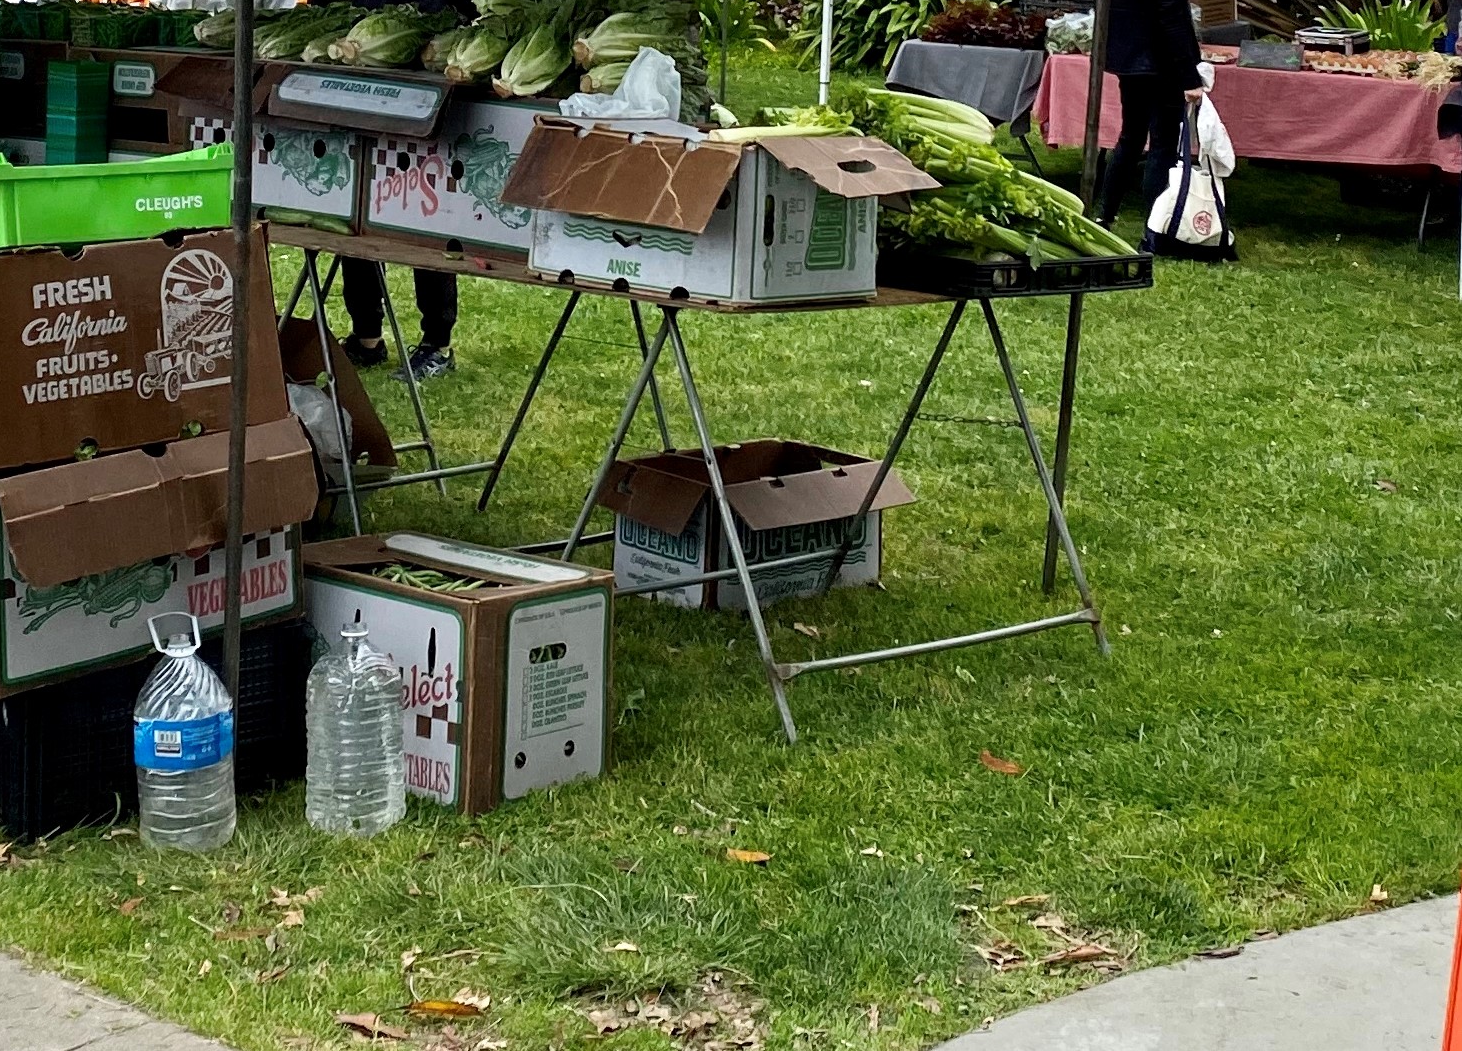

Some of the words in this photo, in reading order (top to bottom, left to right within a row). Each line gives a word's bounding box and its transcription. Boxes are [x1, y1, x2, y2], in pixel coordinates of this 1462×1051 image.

[320, 79, 371, 95] VEGETABLES
[372, 86, 401, 98] FRESH
[375, 154, 444, 217] Select
[135, 195, 203, 212] CLEUGH'S
[606, 258, 642, 277] ANISE
[32, 275, 112, 309] FRESH
[21, 309, 128, 355] California
[22, 369, 134, 404] VEGETABLES
[187, 559, 287, 618] VEGEABLES
[400, 662, 455, 711] elect
[404, 753, 451, 795] TABLES
